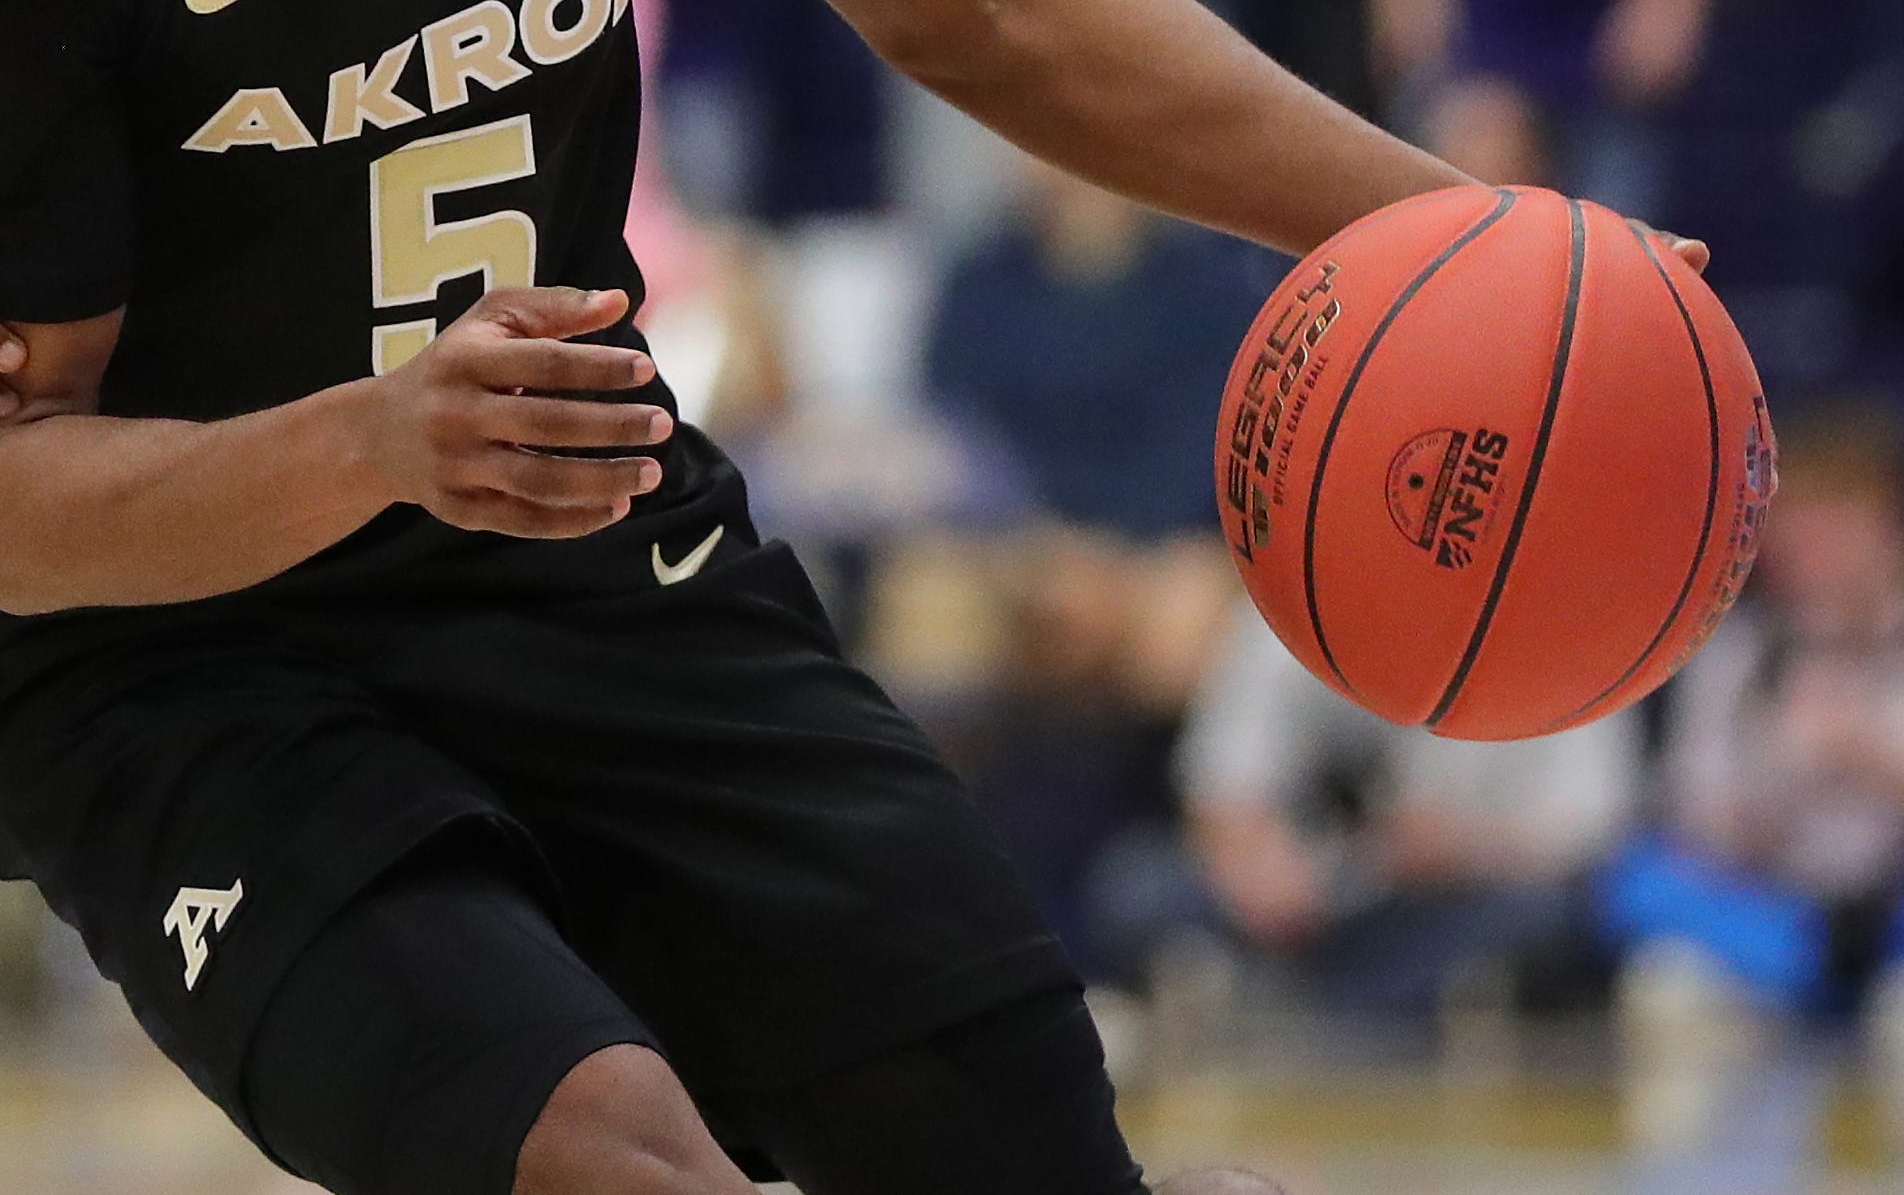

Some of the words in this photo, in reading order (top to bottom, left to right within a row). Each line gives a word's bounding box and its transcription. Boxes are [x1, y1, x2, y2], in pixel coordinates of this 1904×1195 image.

[369, 113, 536, 377] 5
[1228, 261, 1340, 563] LEGACY
[1304, 355, 1329, 390] BALL
[1444, 428, 1509, 542] NFHS
[162, 878, 244, 992] A
